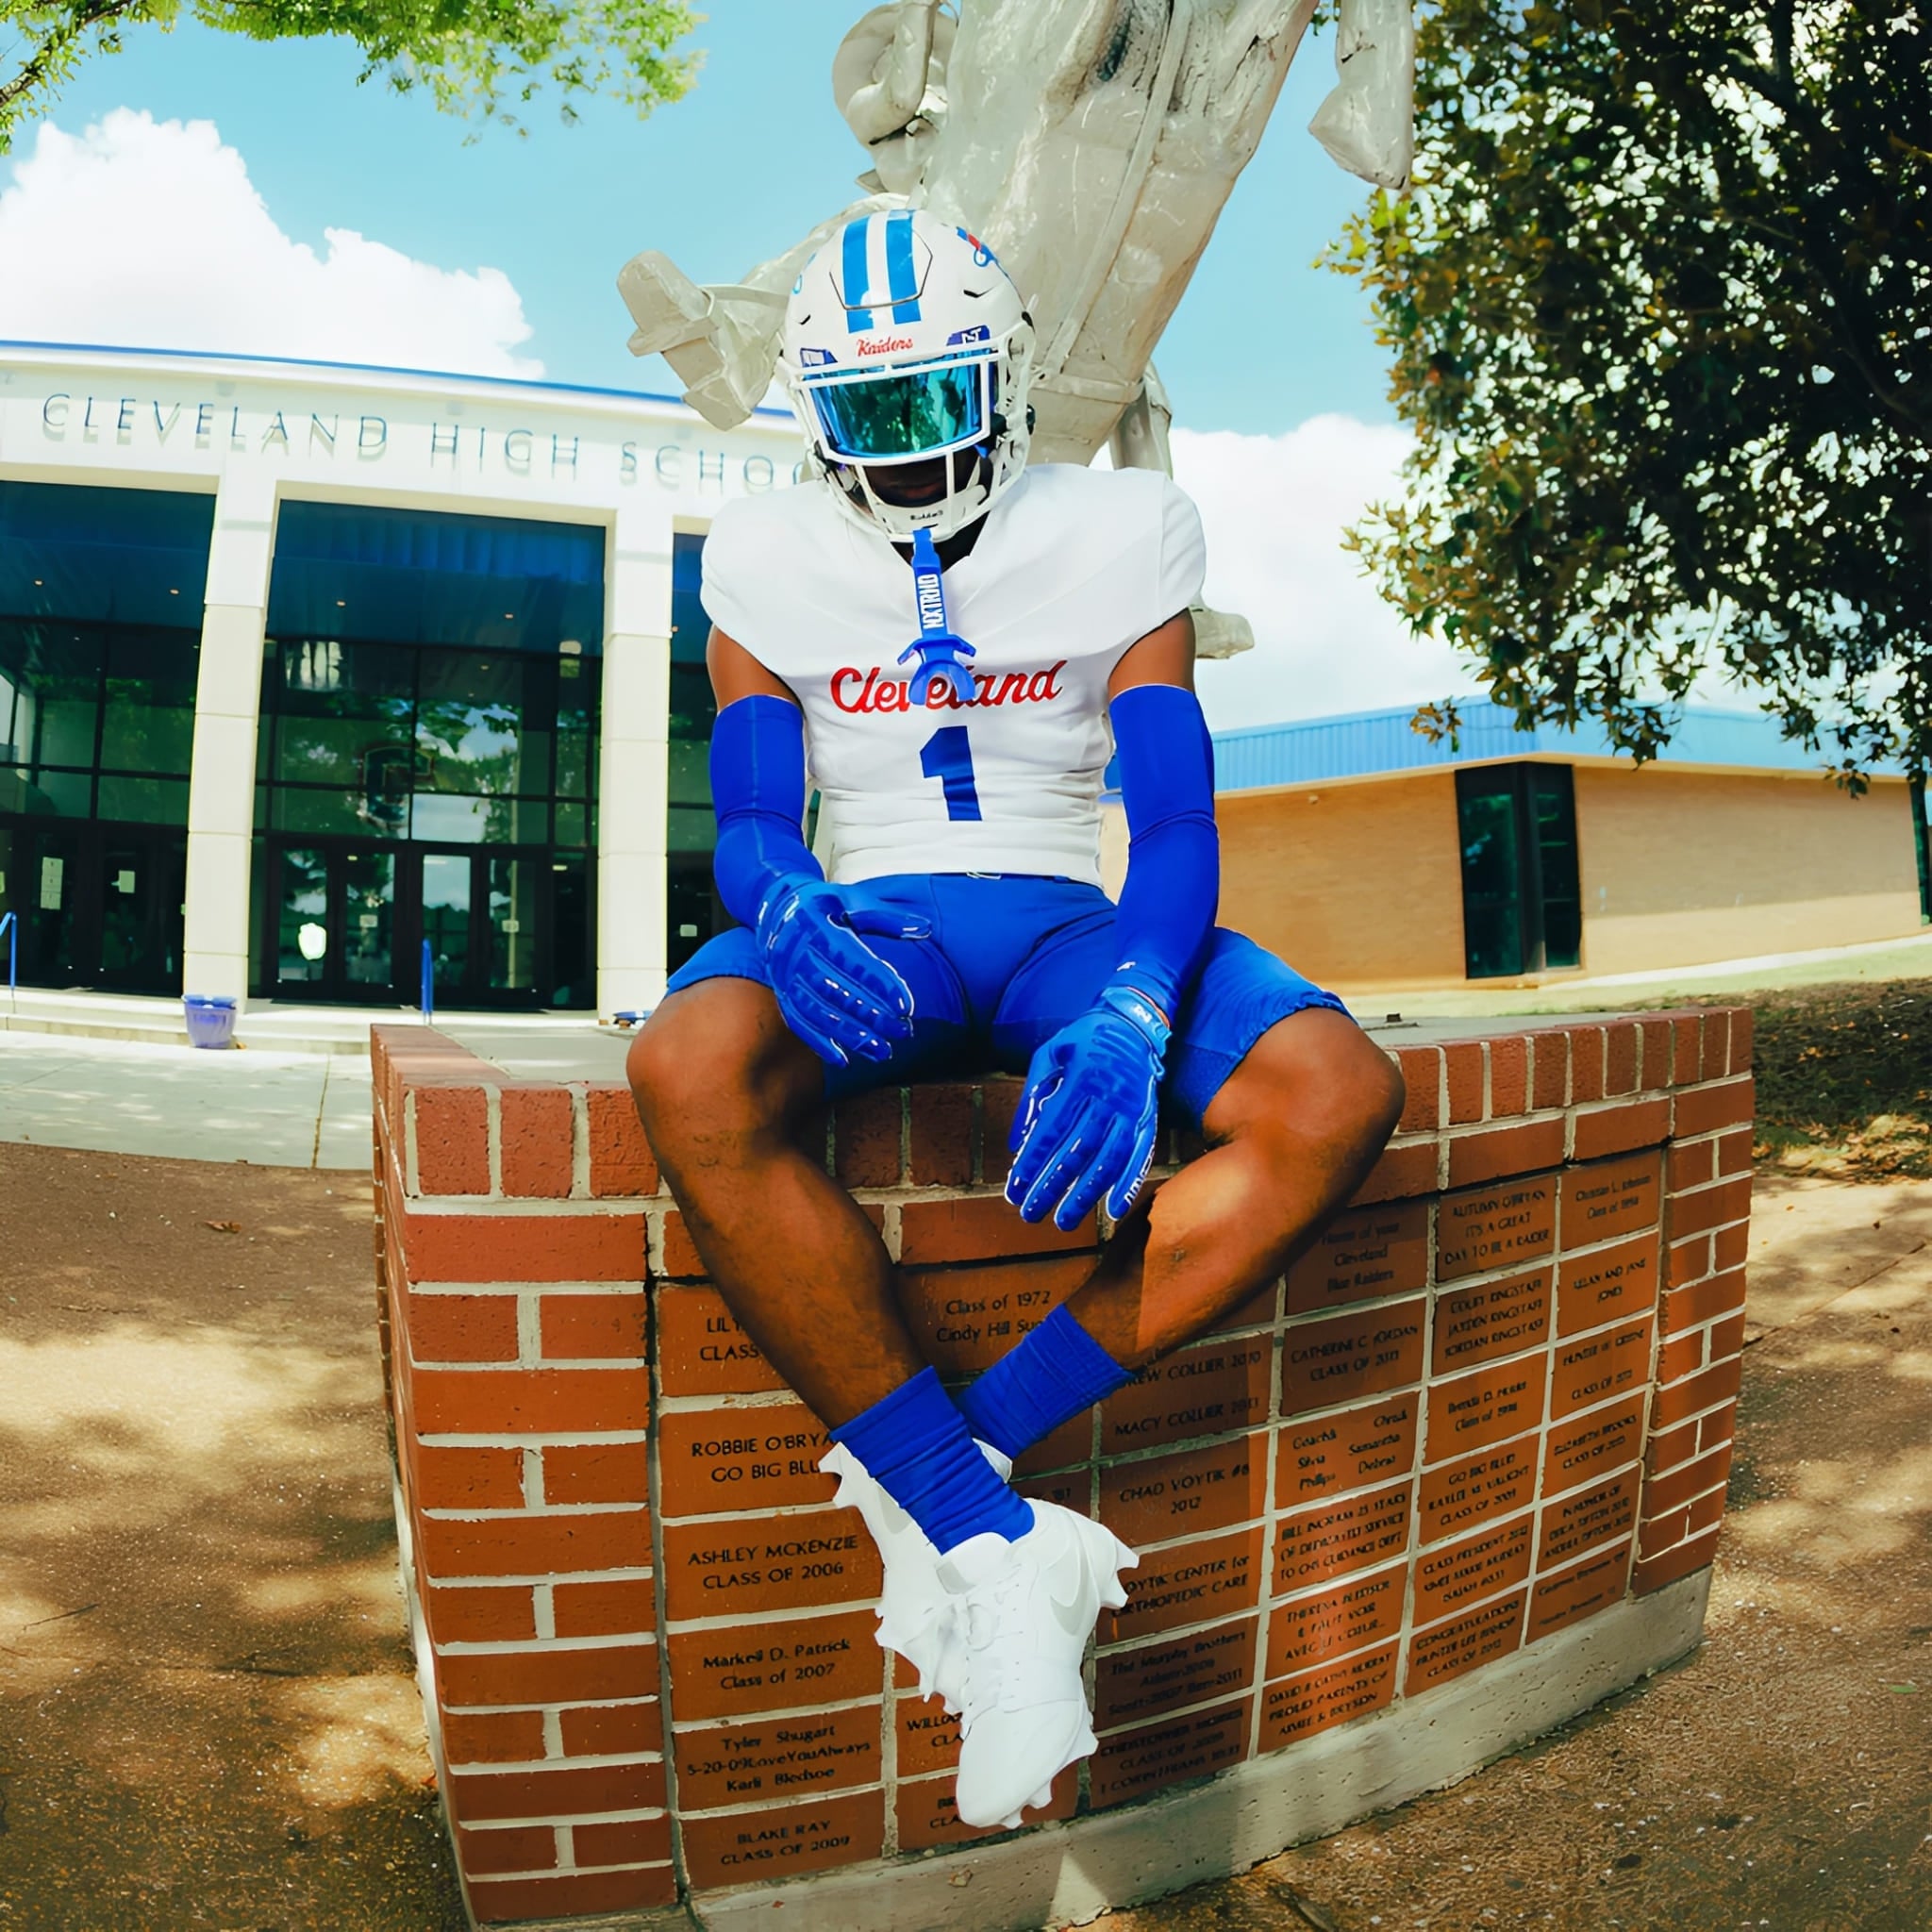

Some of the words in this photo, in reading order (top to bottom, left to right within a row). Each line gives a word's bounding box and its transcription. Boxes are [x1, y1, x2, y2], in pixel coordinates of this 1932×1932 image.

[42, 393, 388, 448] CLEVELAND
[430, 423, 578, 465] HIGH
[621, 441, 803, 487] SCHO
[919, 725, 983, 821] 1
[946, 1300, 986, 1314] Class
[992, 1294, 1008, 1309] of
[1017, 1291, 1051, 1307] 1972
[700, 1343, 760, 1361] CLASS
[1115, 1417, 1161, 1435] MACY
[691, 1439, 758, 1456] ROBBIE
[765, 1433, 833, 1450] O'BRYA
[711, 1467, 742, 1482] GO
[752, 1462, 781, 1478] BIG
[789, 1459, 820, 1474] BLU
[1120, 1482, 1164, 1503] CHAD
[688, 1546, 757, 1565] ASHLEY
[765, 1535, 858, 1558] MCKENZIE
[703, 1572, 760, 1590] CLASS
[768, 1568, 792, 1583] OF
[802, 1563, 843, 1579] 2006
[1124, 1573, 1169, 1591] OYTIK
[1174, 1559, 1225, 1583] CENTER
[1233, 1556, 1249, 1569] for
[1212, 1574, 1248, 1593] CARE
[770, 1647, 789, 1661] D.
[795, 1639, 850, 1657] Patrick
[721, 1675, 761, 1690] Class
[770, 1668, 786, 1683] of
[795, 1663, 835, 1679] 2007
[776, 1725, 835, 1743] Shugart
[932, 1734, 963, 1748] CLA
[774, 1768, 835, 1786] Bledsoe
[738, 1828, 789, 1844] BLAKE
[795, 1821, 831, 1835] RAY
[929, 1816, 962, 1828] CLA
[721, 1849, 774, 1865] CLASS
[780, 1844, 803, 1856] OF
[811, 1836, 850, 1851] 2009
